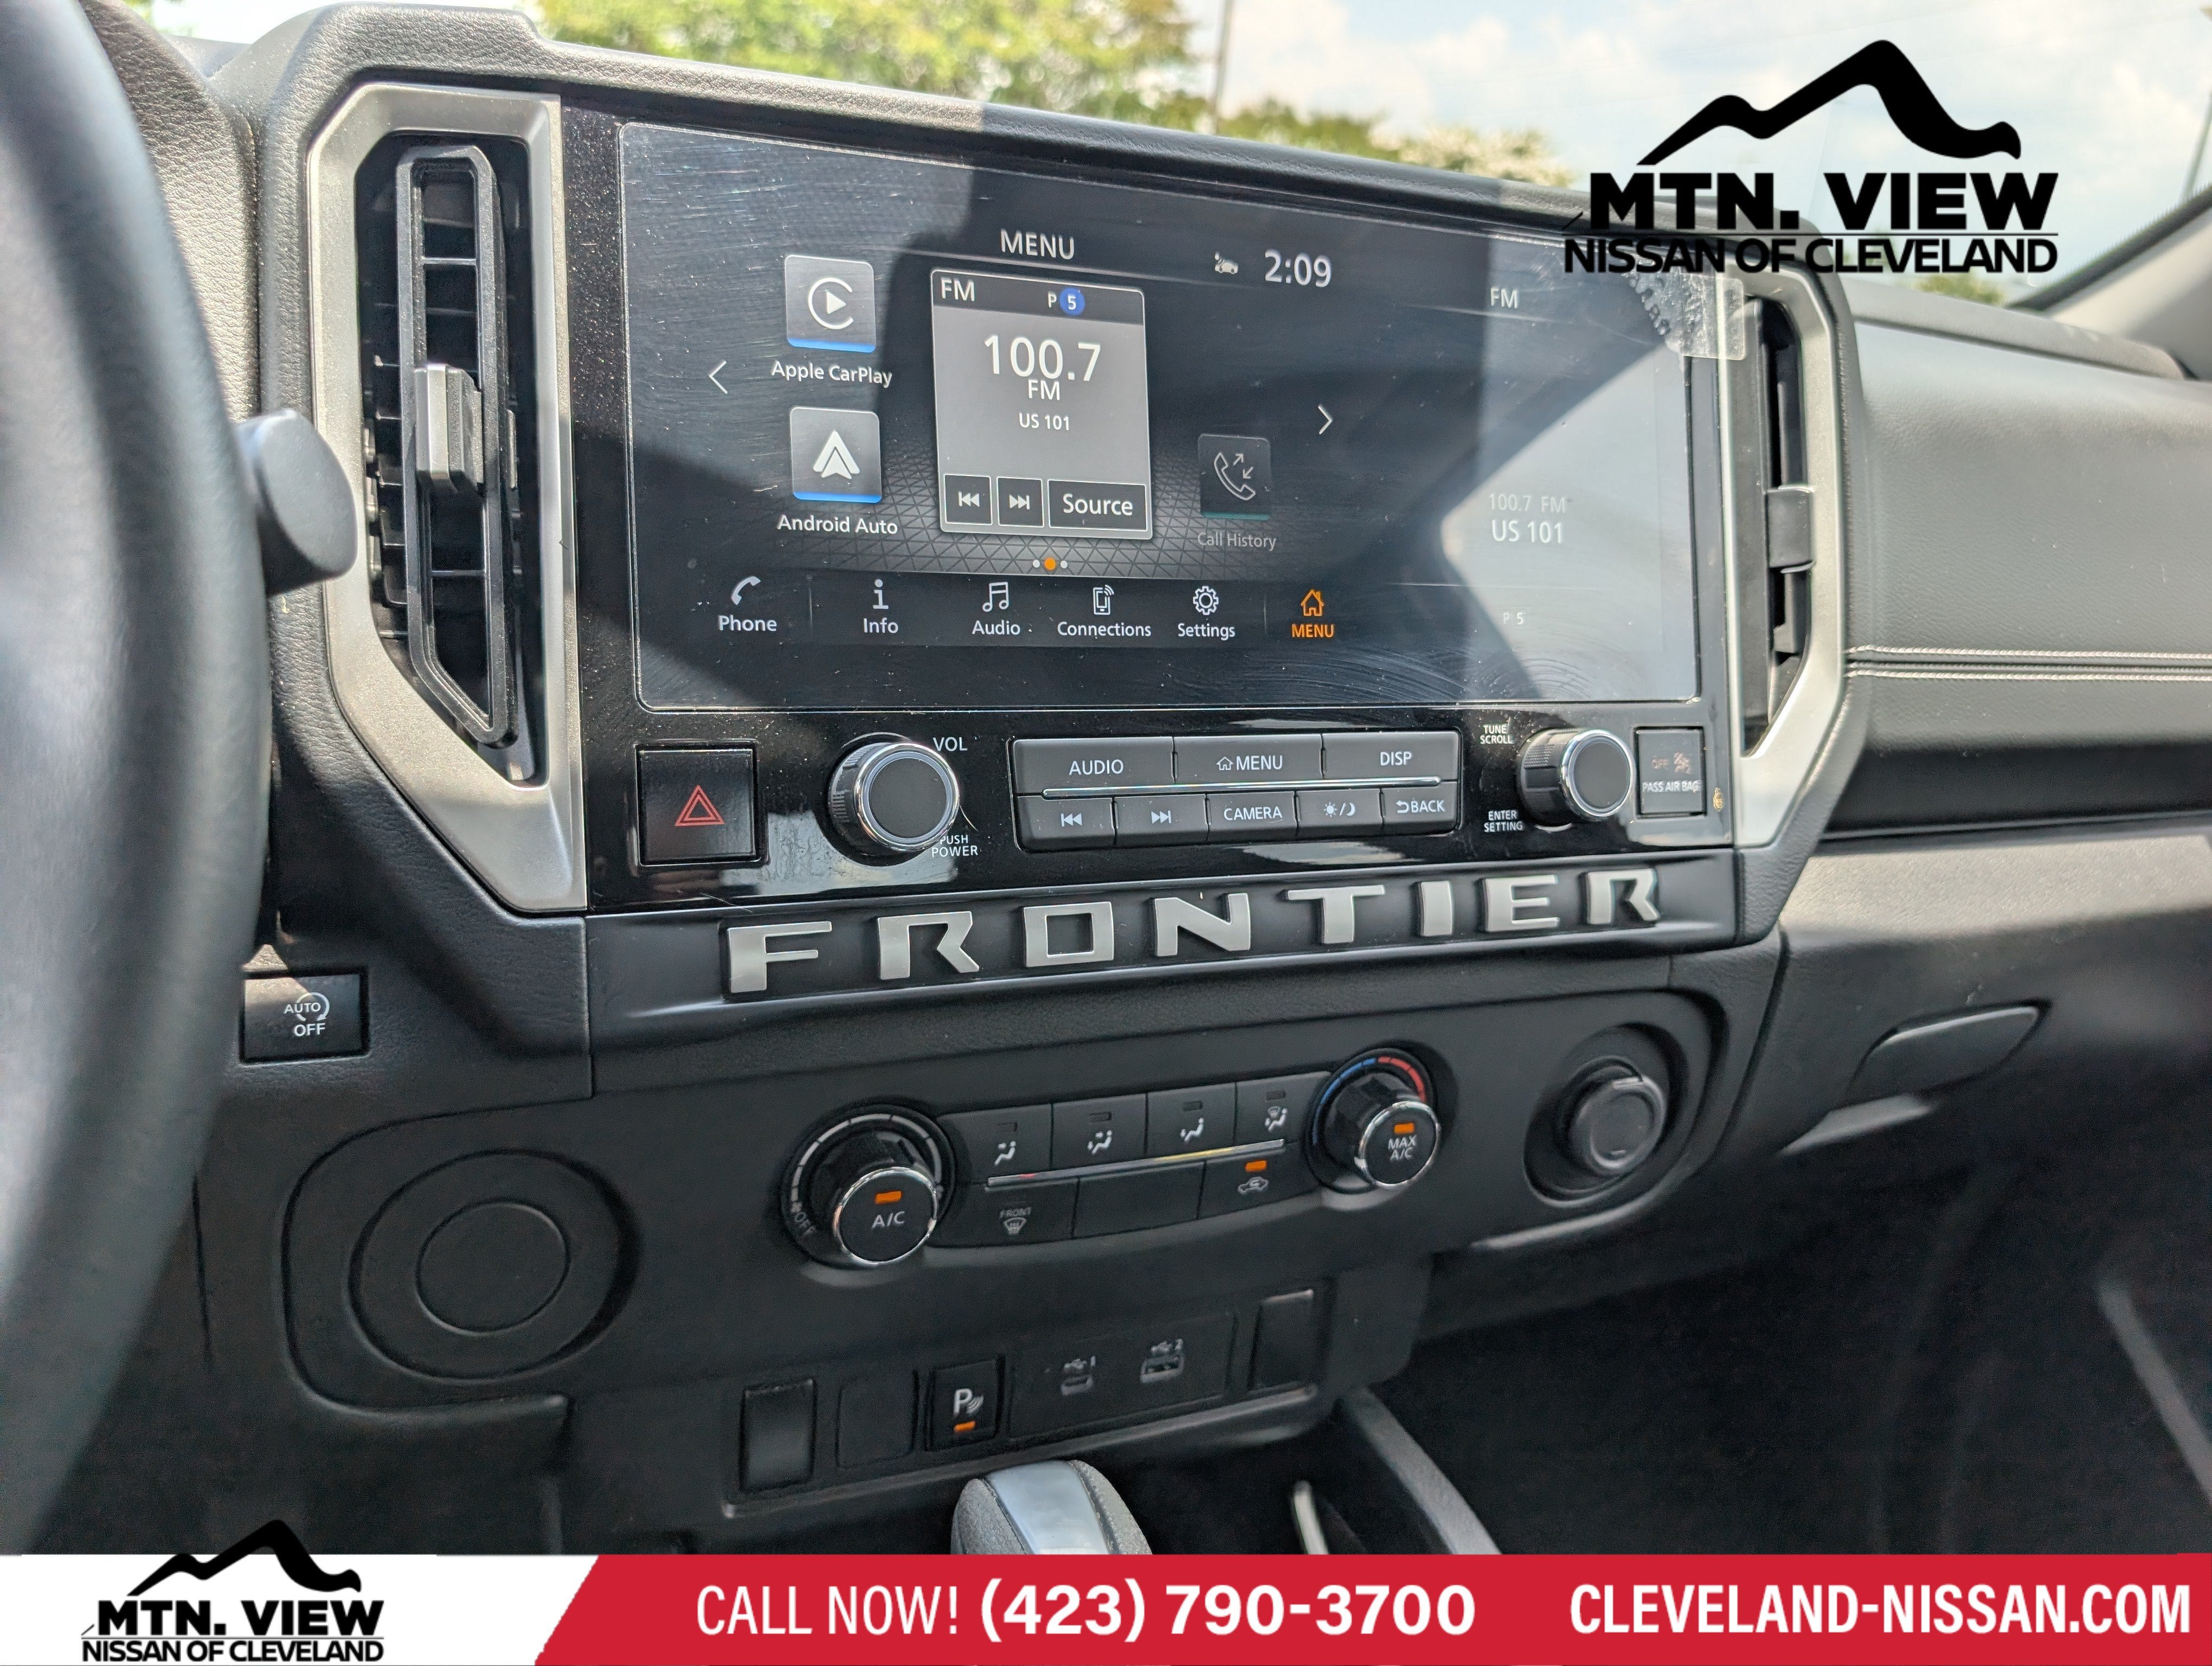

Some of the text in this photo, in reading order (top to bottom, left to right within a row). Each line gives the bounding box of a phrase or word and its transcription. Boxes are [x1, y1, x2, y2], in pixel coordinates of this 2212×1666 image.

[1000, 229, 1075, 259] MENU
[1264, 249, 1332, 287] 2:09
[941, 277, 975, 302] FM
[1047, 291, 1076, 310] P 5
[1490, 288, 1519, 309] FM
[983, 334, 1101, 382] 100.7
[771, 361, 892, 388] Apple CarPlay
[1027, 380, 1060, 401] FM
[1019, 413, 1070, 431] US 101
[1063, 493, 1133, 516] Source
[1489, 494, 1566, 513] 100.7 FM
[777, 514, 898, 535] Android Auto
[1492, 520, 1562, 543] US 101
[1198, 531, 1277, 550] Call History
[718, 615, 777, 632] Phone
[863, 617, 899, 634] Info
[972, 620, 1020, 636] Audio
[1057, 621, 1152, 637] Connections
[1178, 622, 1236, 641] Settings
[1292, 624, 1335, 639] MENU
[1483, 725, 1507, 735] TUNE
[933, 736, 967, 752] VOL
[1480, 735, 1514, 745] SCROLL
[1236, 755, 1283, 772] MENU
[1380, 751, 1412, 766] DISP
[1069, 759, 1124, 776] AUDIO
[1642, 780, 1702, 792] PASS AIR BAG
[1224, 806, 1283, 822] CAMERA
[1411, 799, 1445, 814] BACK
[1488, 810, 1516, 821] ENTER
[1484, 821, 1523, 832] SETTING
[940, 835, 968, 845] PUSH
[932, 845, 978, 857] POWER
[728, 868, 1661, 993] FRONTIER
[284, 1002, 321, 1014] AUTO
[294, 1023, 325, 1036] OFF
[1388, 1135, 1417, 1149] MAX
[1390, 1146, 1413, 1161] A/C
[871, 1211, 905, 1228] A/C
